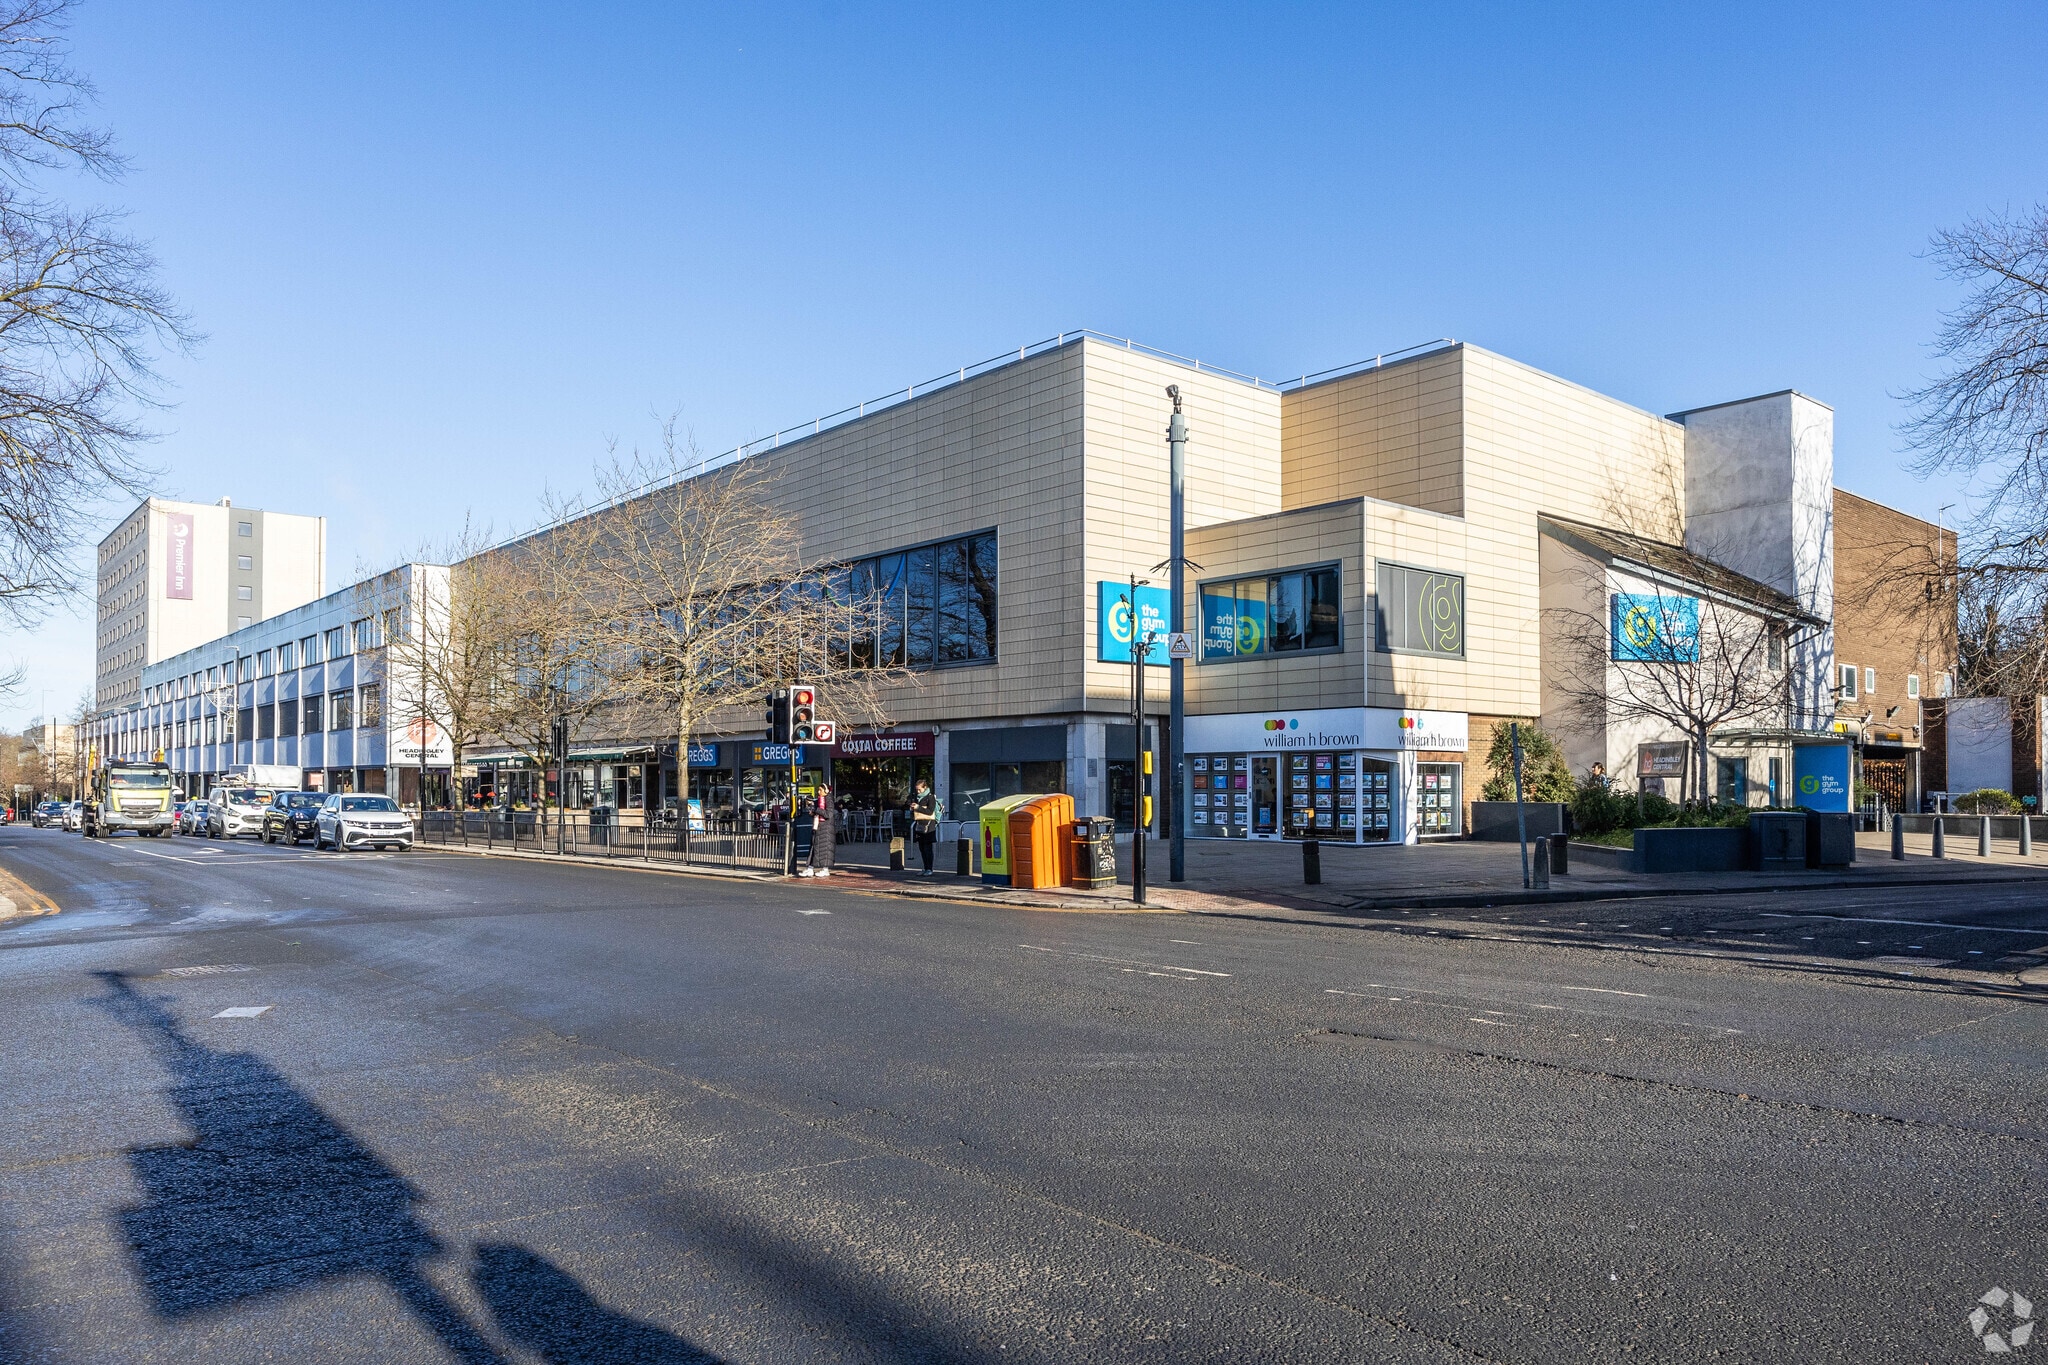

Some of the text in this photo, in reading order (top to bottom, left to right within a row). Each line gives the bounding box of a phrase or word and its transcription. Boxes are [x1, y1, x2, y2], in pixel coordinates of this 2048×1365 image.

[175, 538, 186, 591] Premier Inn
[1141, 603, 1159, 617] the
[1141, 617, 1166, 631] gym
[841, 737, 917, 754] COSTA COFFEE
[1264, 732, 1360, 747] william h brown
[1398, 733, 1465, 748] william h brown
[687, 749, 714, 762] REGGS
[1821, 780, 1839, 788] gym
[1821, 787, 1844, 795] group
